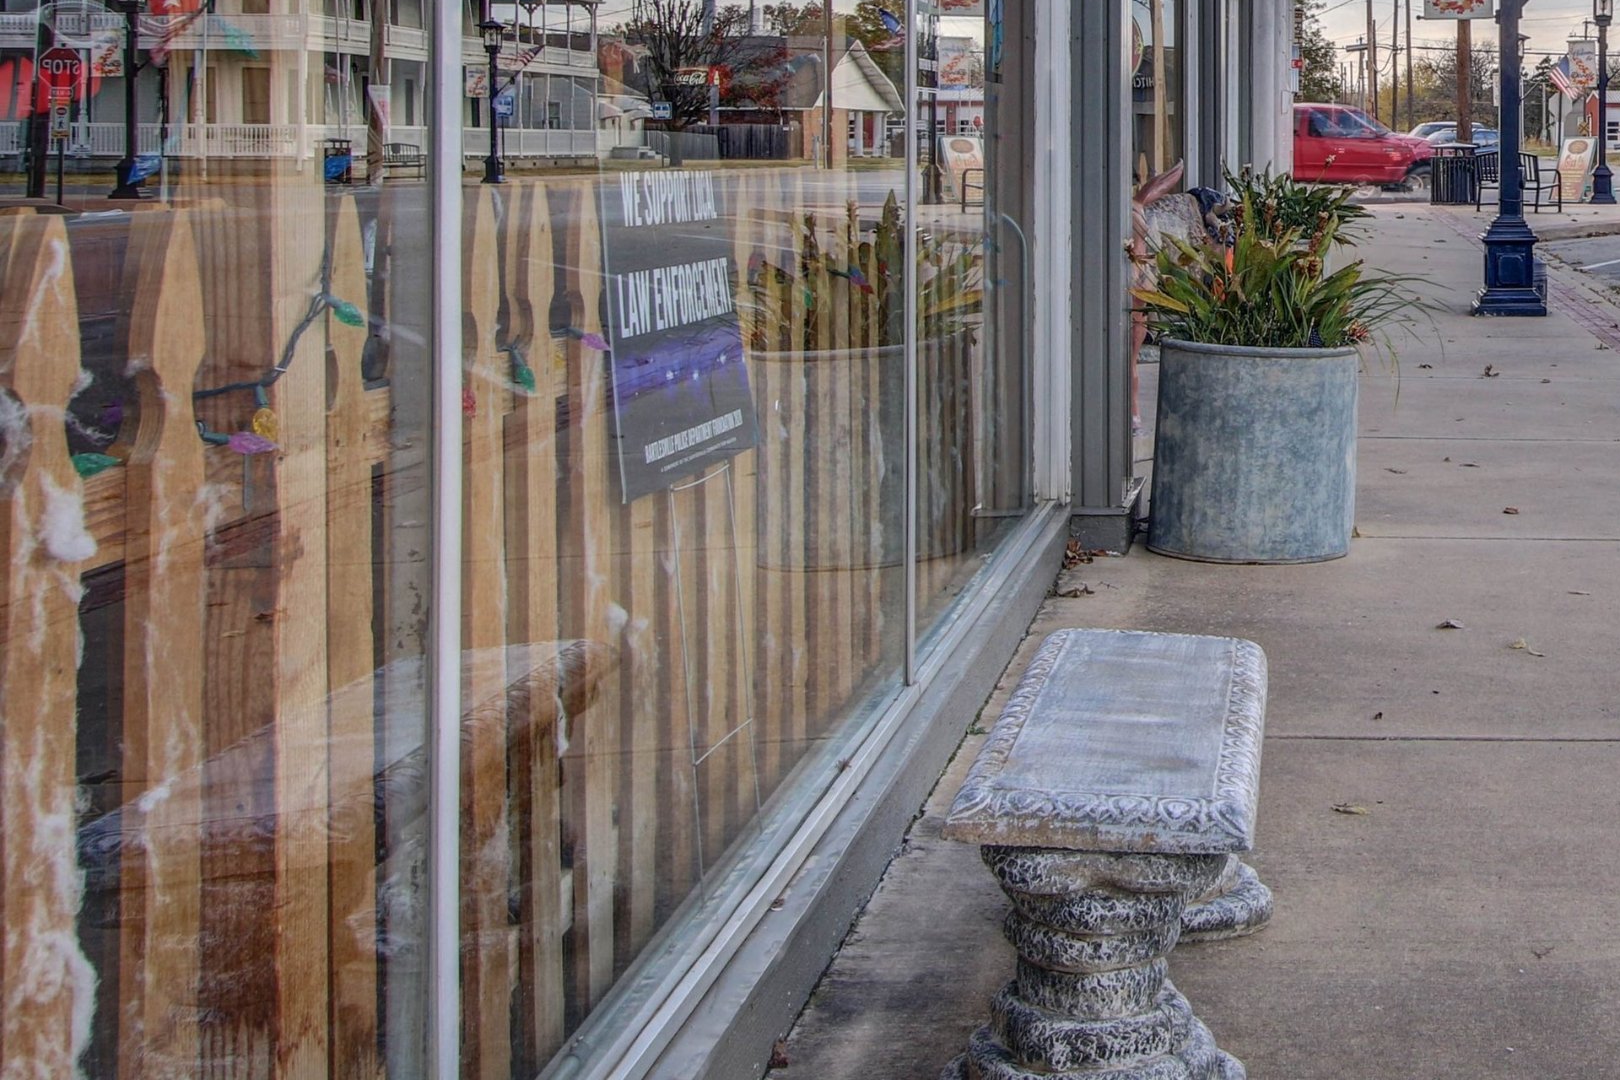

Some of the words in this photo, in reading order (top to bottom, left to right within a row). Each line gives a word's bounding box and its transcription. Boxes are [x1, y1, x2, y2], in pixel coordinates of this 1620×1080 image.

[620, 171, 642, 227] WE
[643, 170, 693, 226] SUPPORT
[689, 170, 717, 221] LOCAL
[617, 270, 651, 338] LAW
[653, 257, 732, 330] ENFORCEMENT
